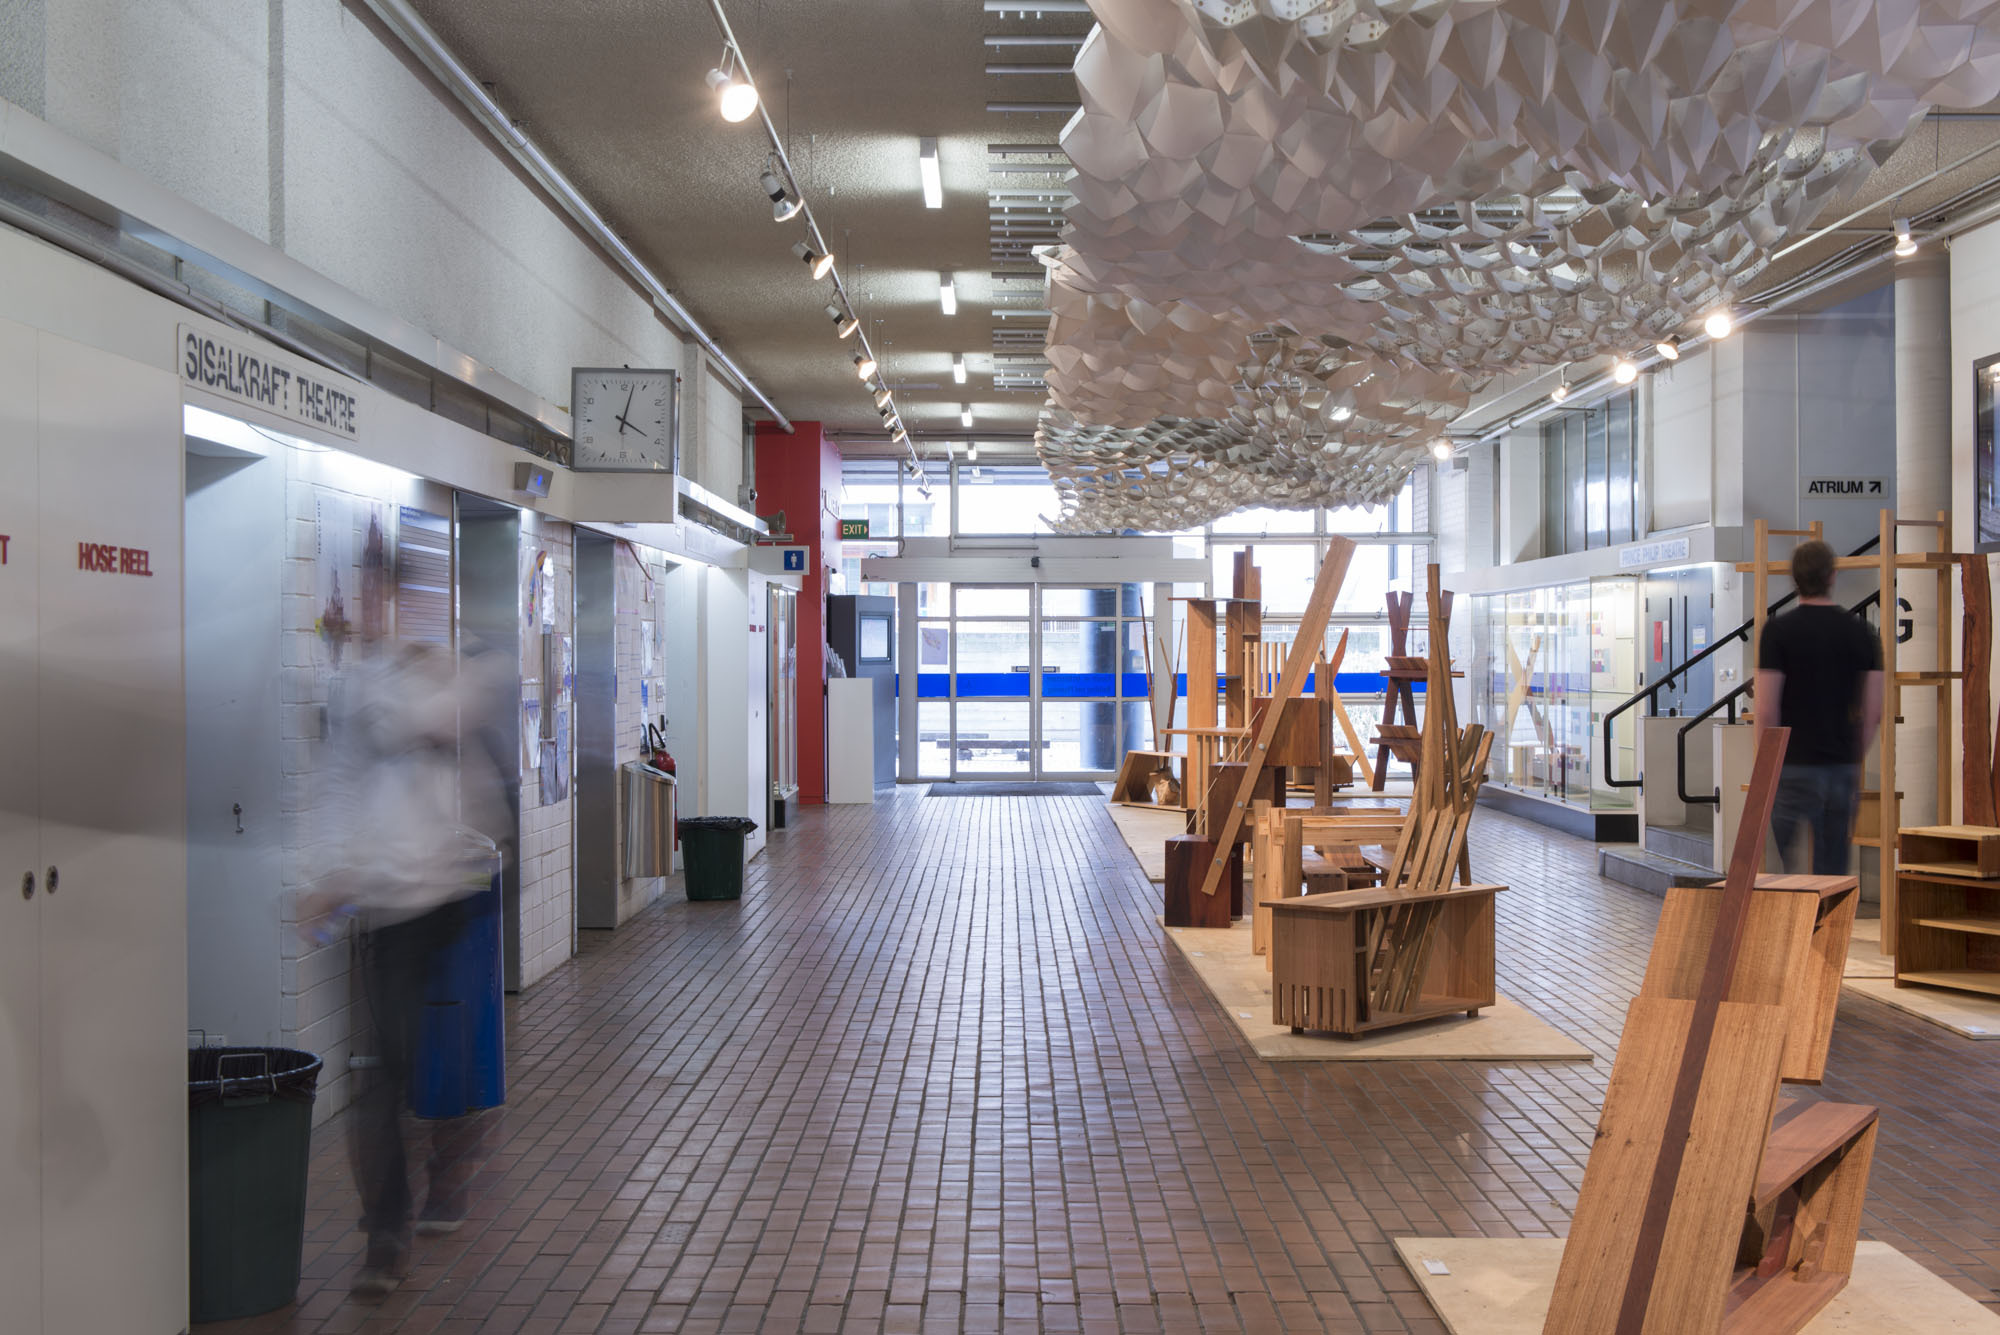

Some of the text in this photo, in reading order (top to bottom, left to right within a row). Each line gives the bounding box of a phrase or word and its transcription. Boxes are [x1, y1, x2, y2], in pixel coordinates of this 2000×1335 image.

[186, 333, 355, 433] SISALKRAFT THEATRE
[1808, 481, 1863, 493] ATRIUM
[843, 524, 862, 535] EXIT
[78, 542, 153, 576] HOSE REEL
